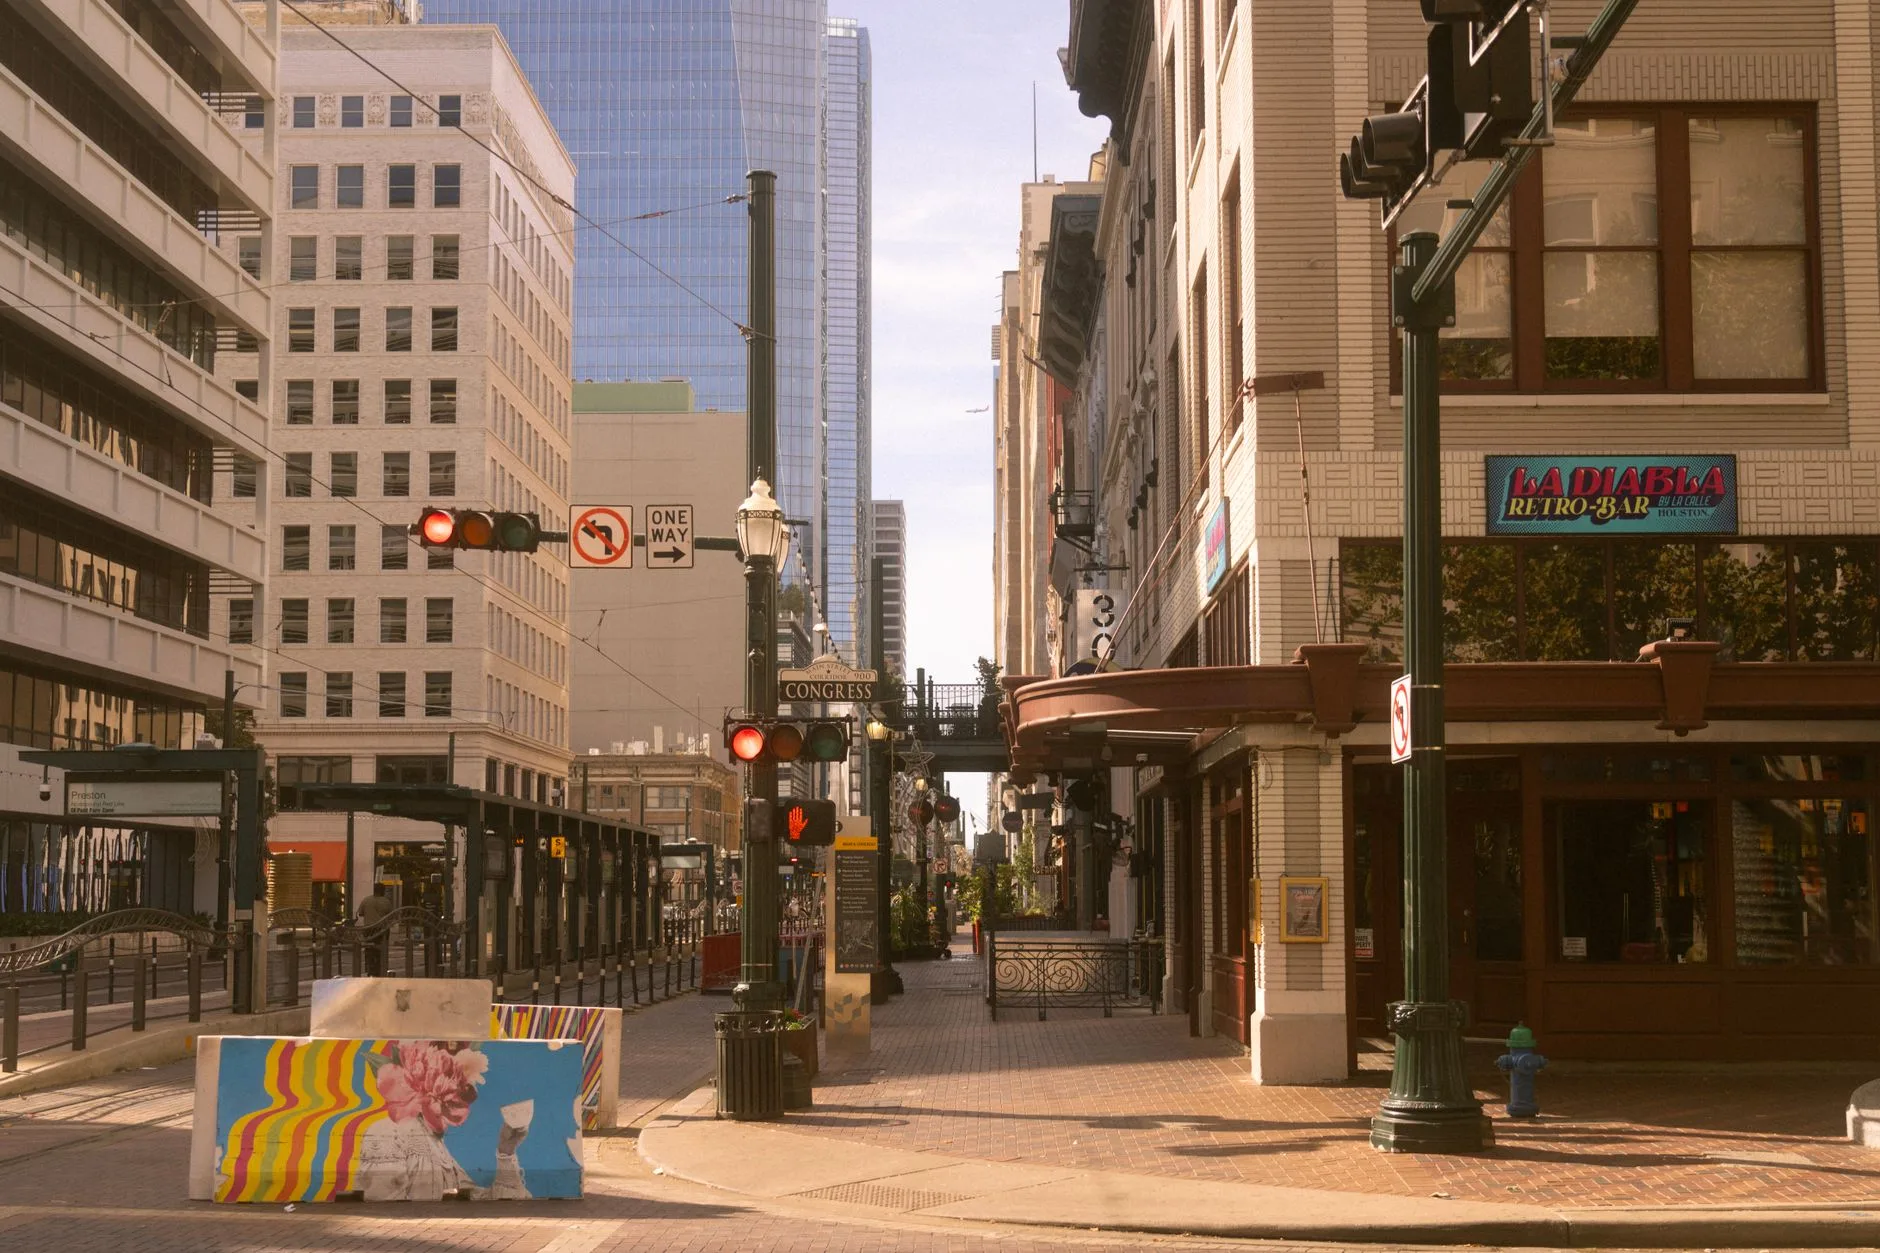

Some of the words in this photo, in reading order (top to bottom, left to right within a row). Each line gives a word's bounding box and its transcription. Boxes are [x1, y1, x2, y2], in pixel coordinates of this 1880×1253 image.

[1512, 466, 1563, 496] LA
[1571, 466, 1726, 496] DIABLA
[1507, 496, 1650, 519] RETRO-BAR
[1658, 495, 1670, 506] BY
[1671, 495, 1682, 506] LA
[1684, 495, 1711, 506] CALLE
[652, 510, 688, 525] ONE
[651, 528, 688, 542] WAY
[806, 663, 825, 674] MAIN
[826, 663, 851, 675] STREET
[854, 672, 872, 680] 900
[785, 683, 872, 699] CONGRESS
[71, 790, 106, 800] Preston
